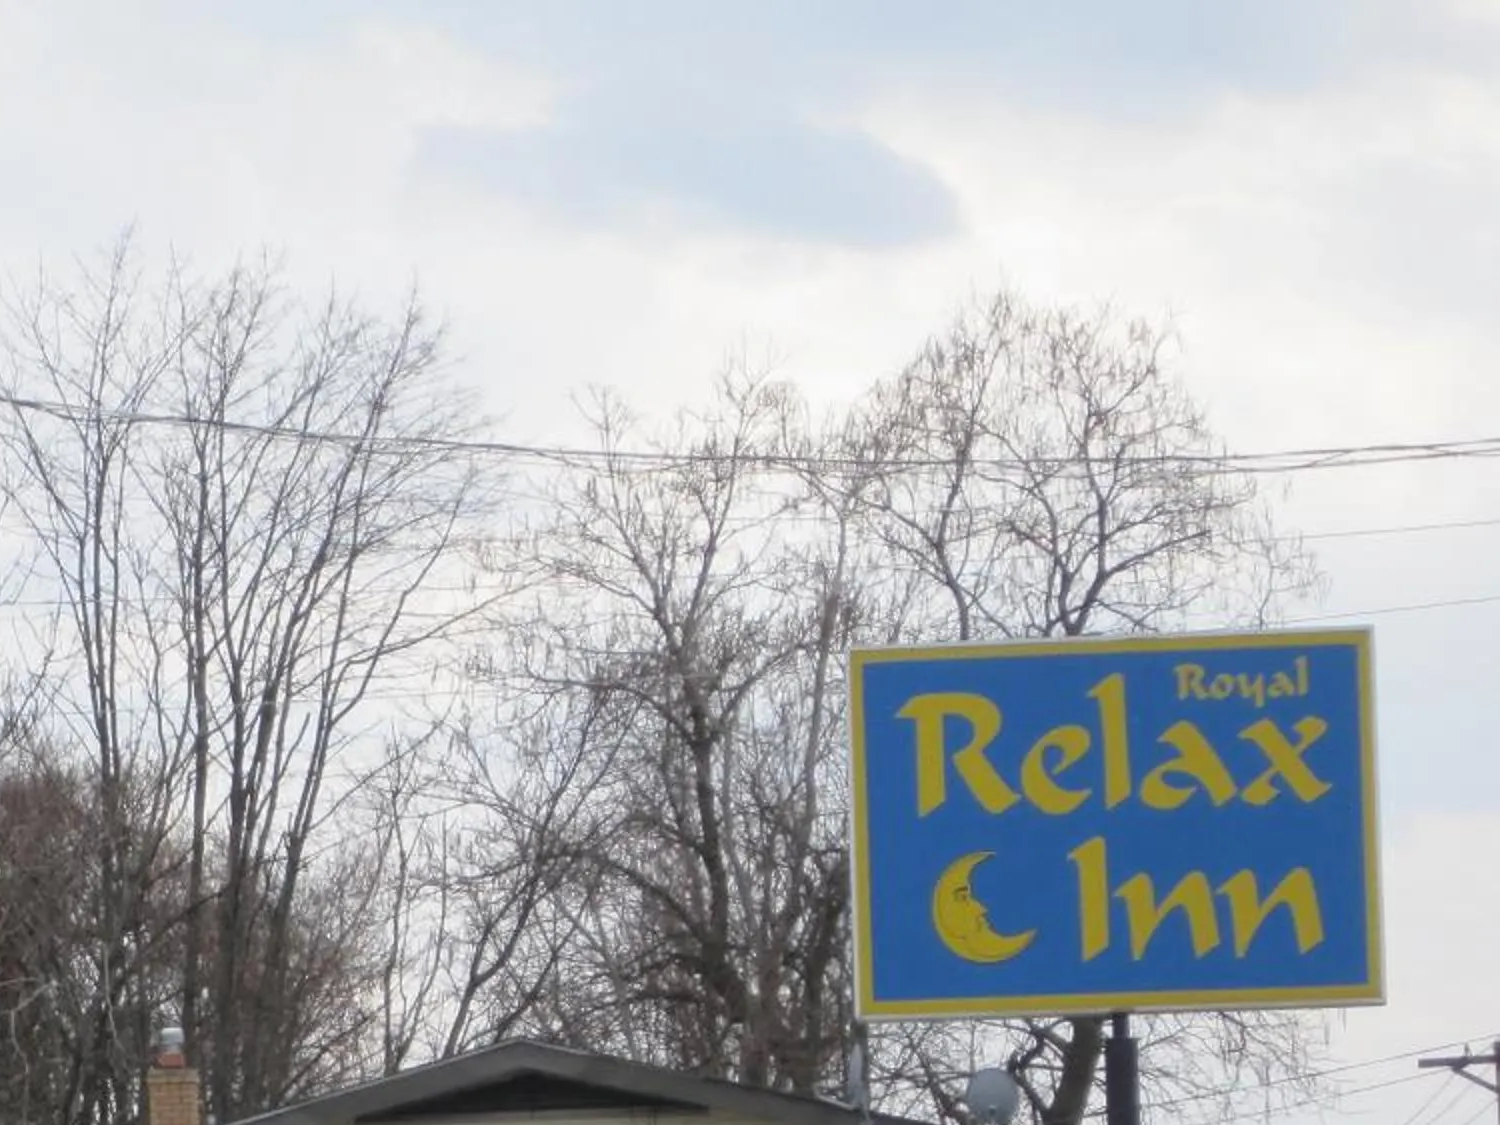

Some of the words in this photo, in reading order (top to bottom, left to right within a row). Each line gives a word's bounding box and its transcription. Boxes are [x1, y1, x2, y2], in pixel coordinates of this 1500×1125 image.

[894, 672, 1333, 819] Relax
[1174, 656, 1309, 707] Royal
[1067, 835, 1325, 963] Inn
